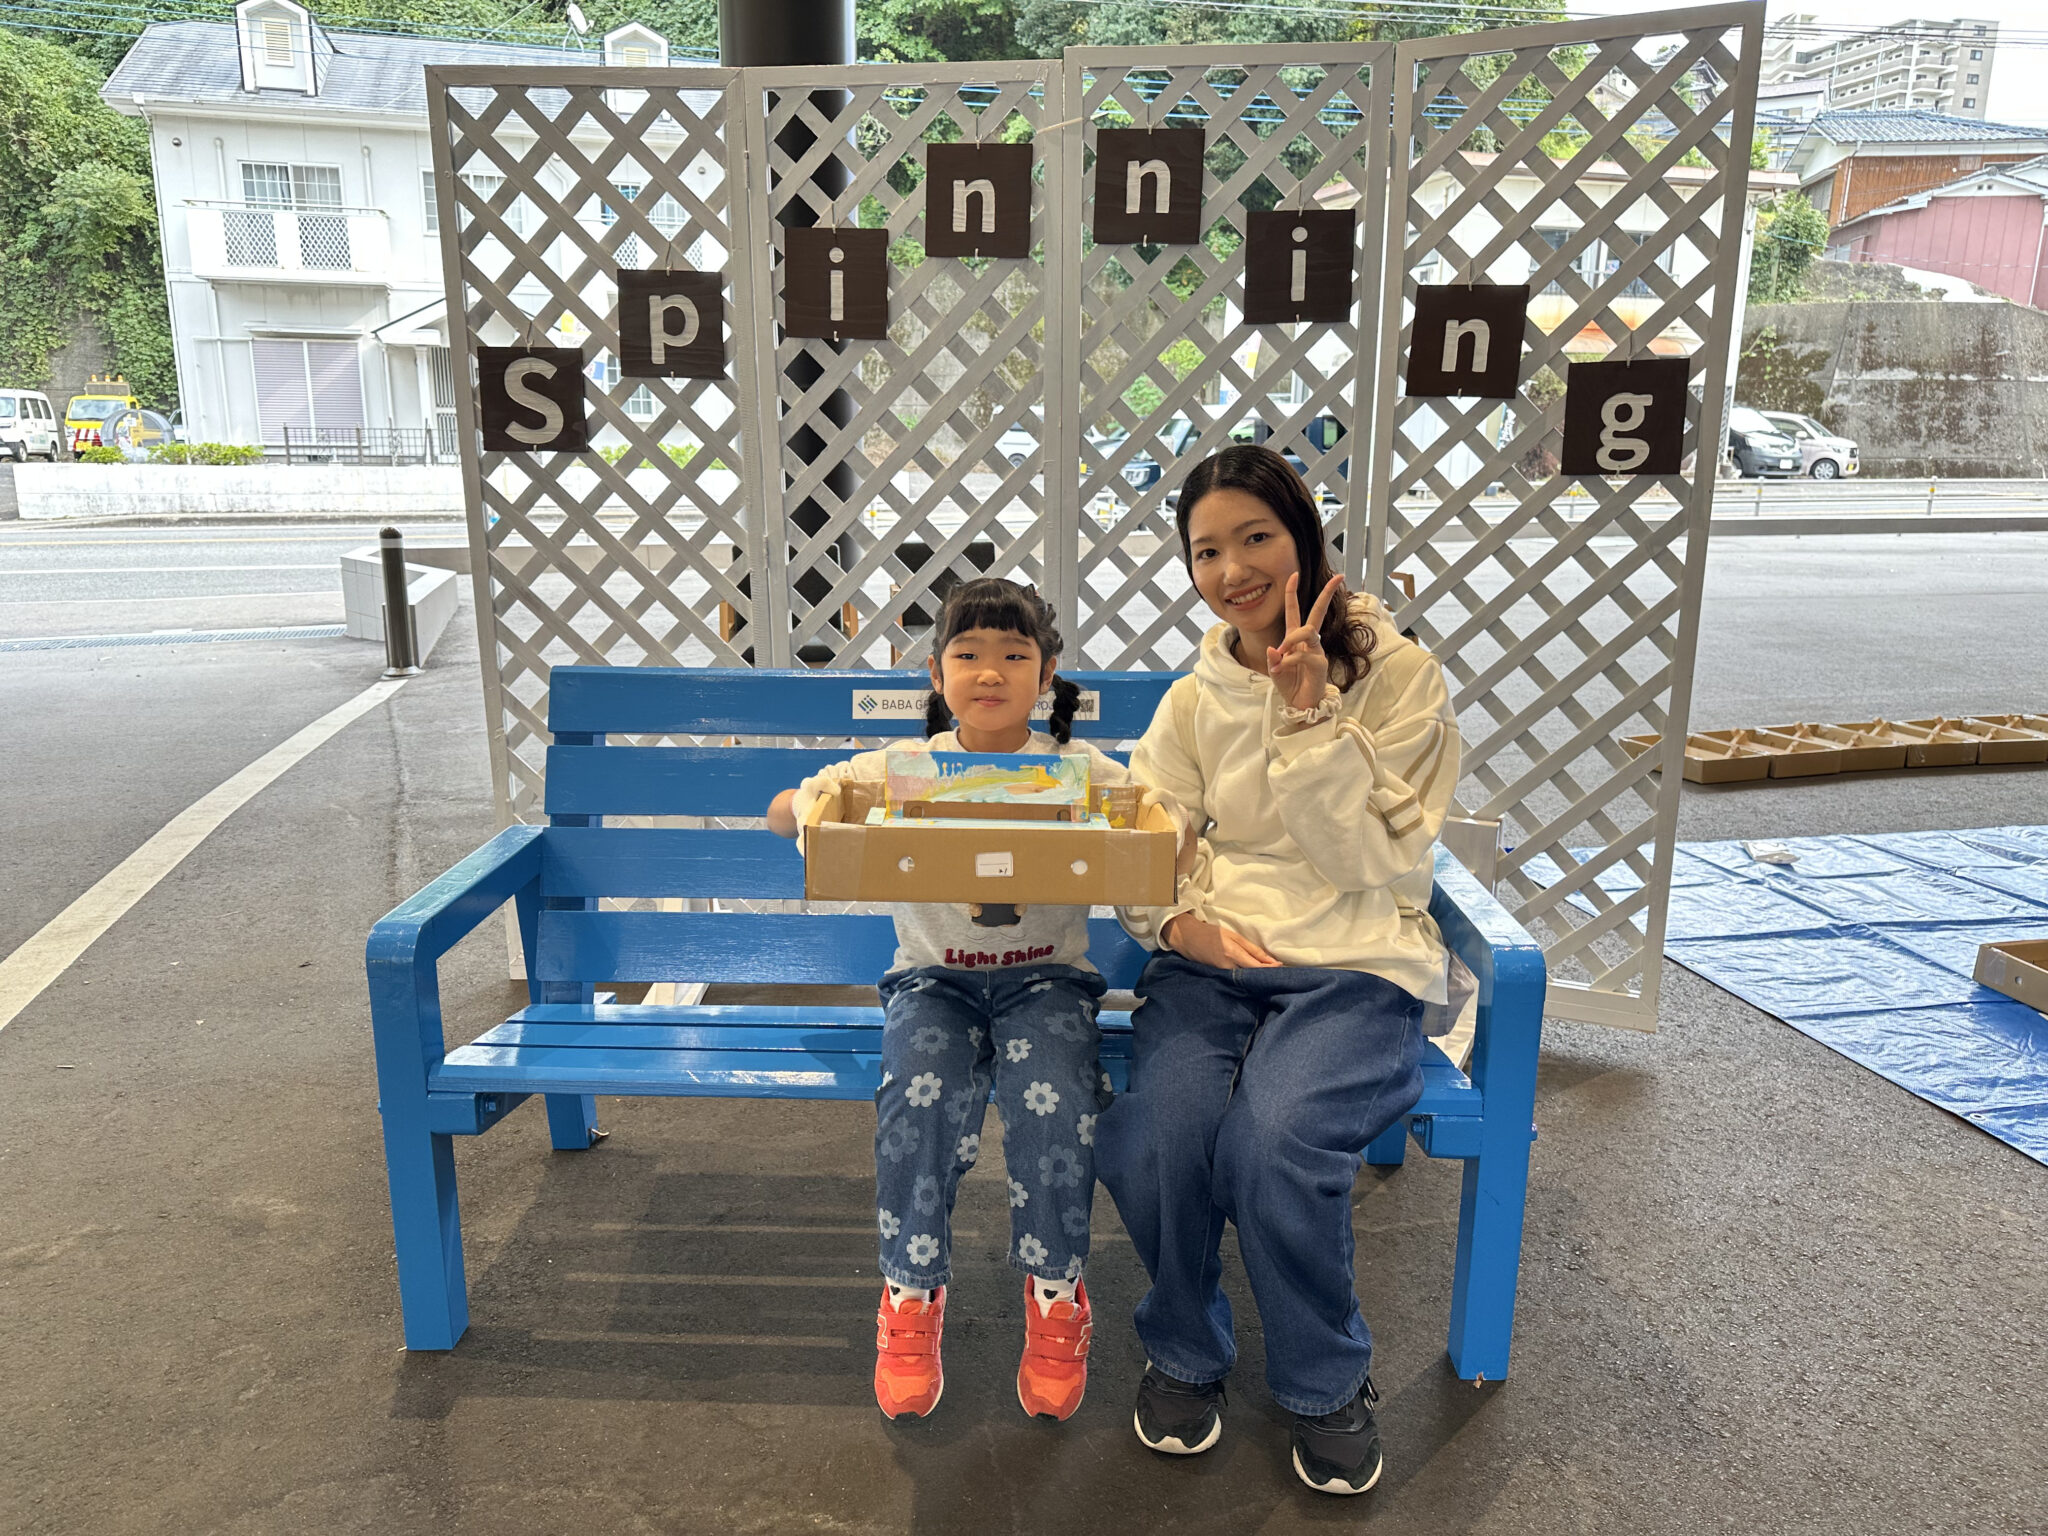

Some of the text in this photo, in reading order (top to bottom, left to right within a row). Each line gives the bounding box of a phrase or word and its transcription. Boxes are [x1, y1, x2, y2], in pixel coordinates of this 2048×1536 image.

[882, 699, 912, 710] BABA
[944, 944, 1055, 968] Light Shine
